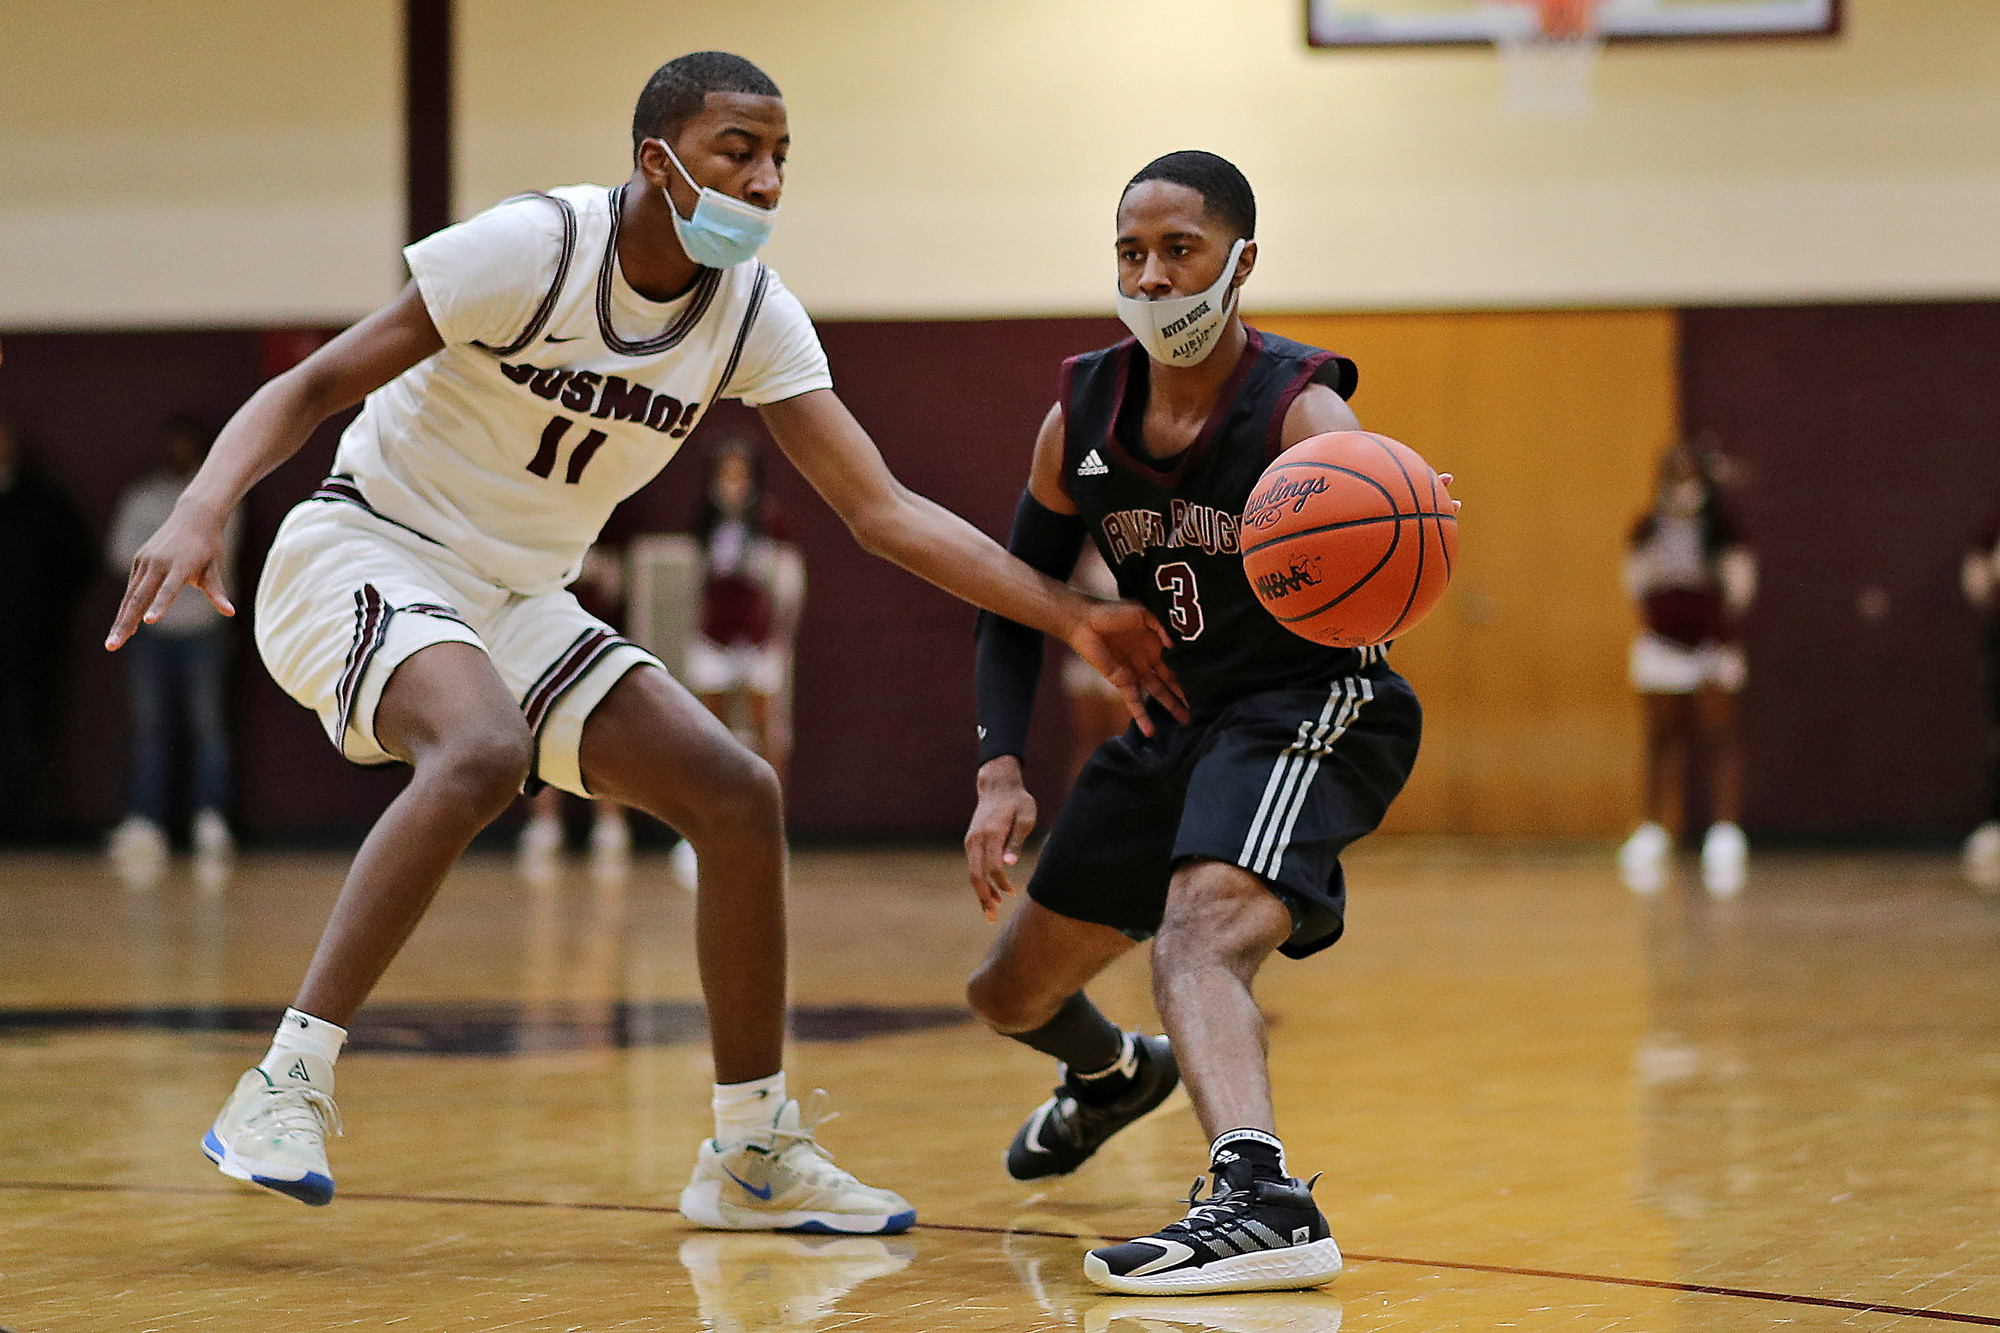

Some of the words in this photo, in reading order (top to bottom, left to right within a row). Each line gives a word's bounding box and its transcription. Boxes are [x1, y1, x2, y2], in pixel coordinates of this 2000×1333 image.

[1162, 317, 1188, 339] RIVER
[1186, 301, 1211, 324] ROUGE
[526, 415, 608, 484] 11
[1102, 508, 1166, 564] RIVER
[1167, 499, 1243, 556] ROUG
[1243, 476, 1330, 525] awlings
[1155, 561, 1205, 641] 3
